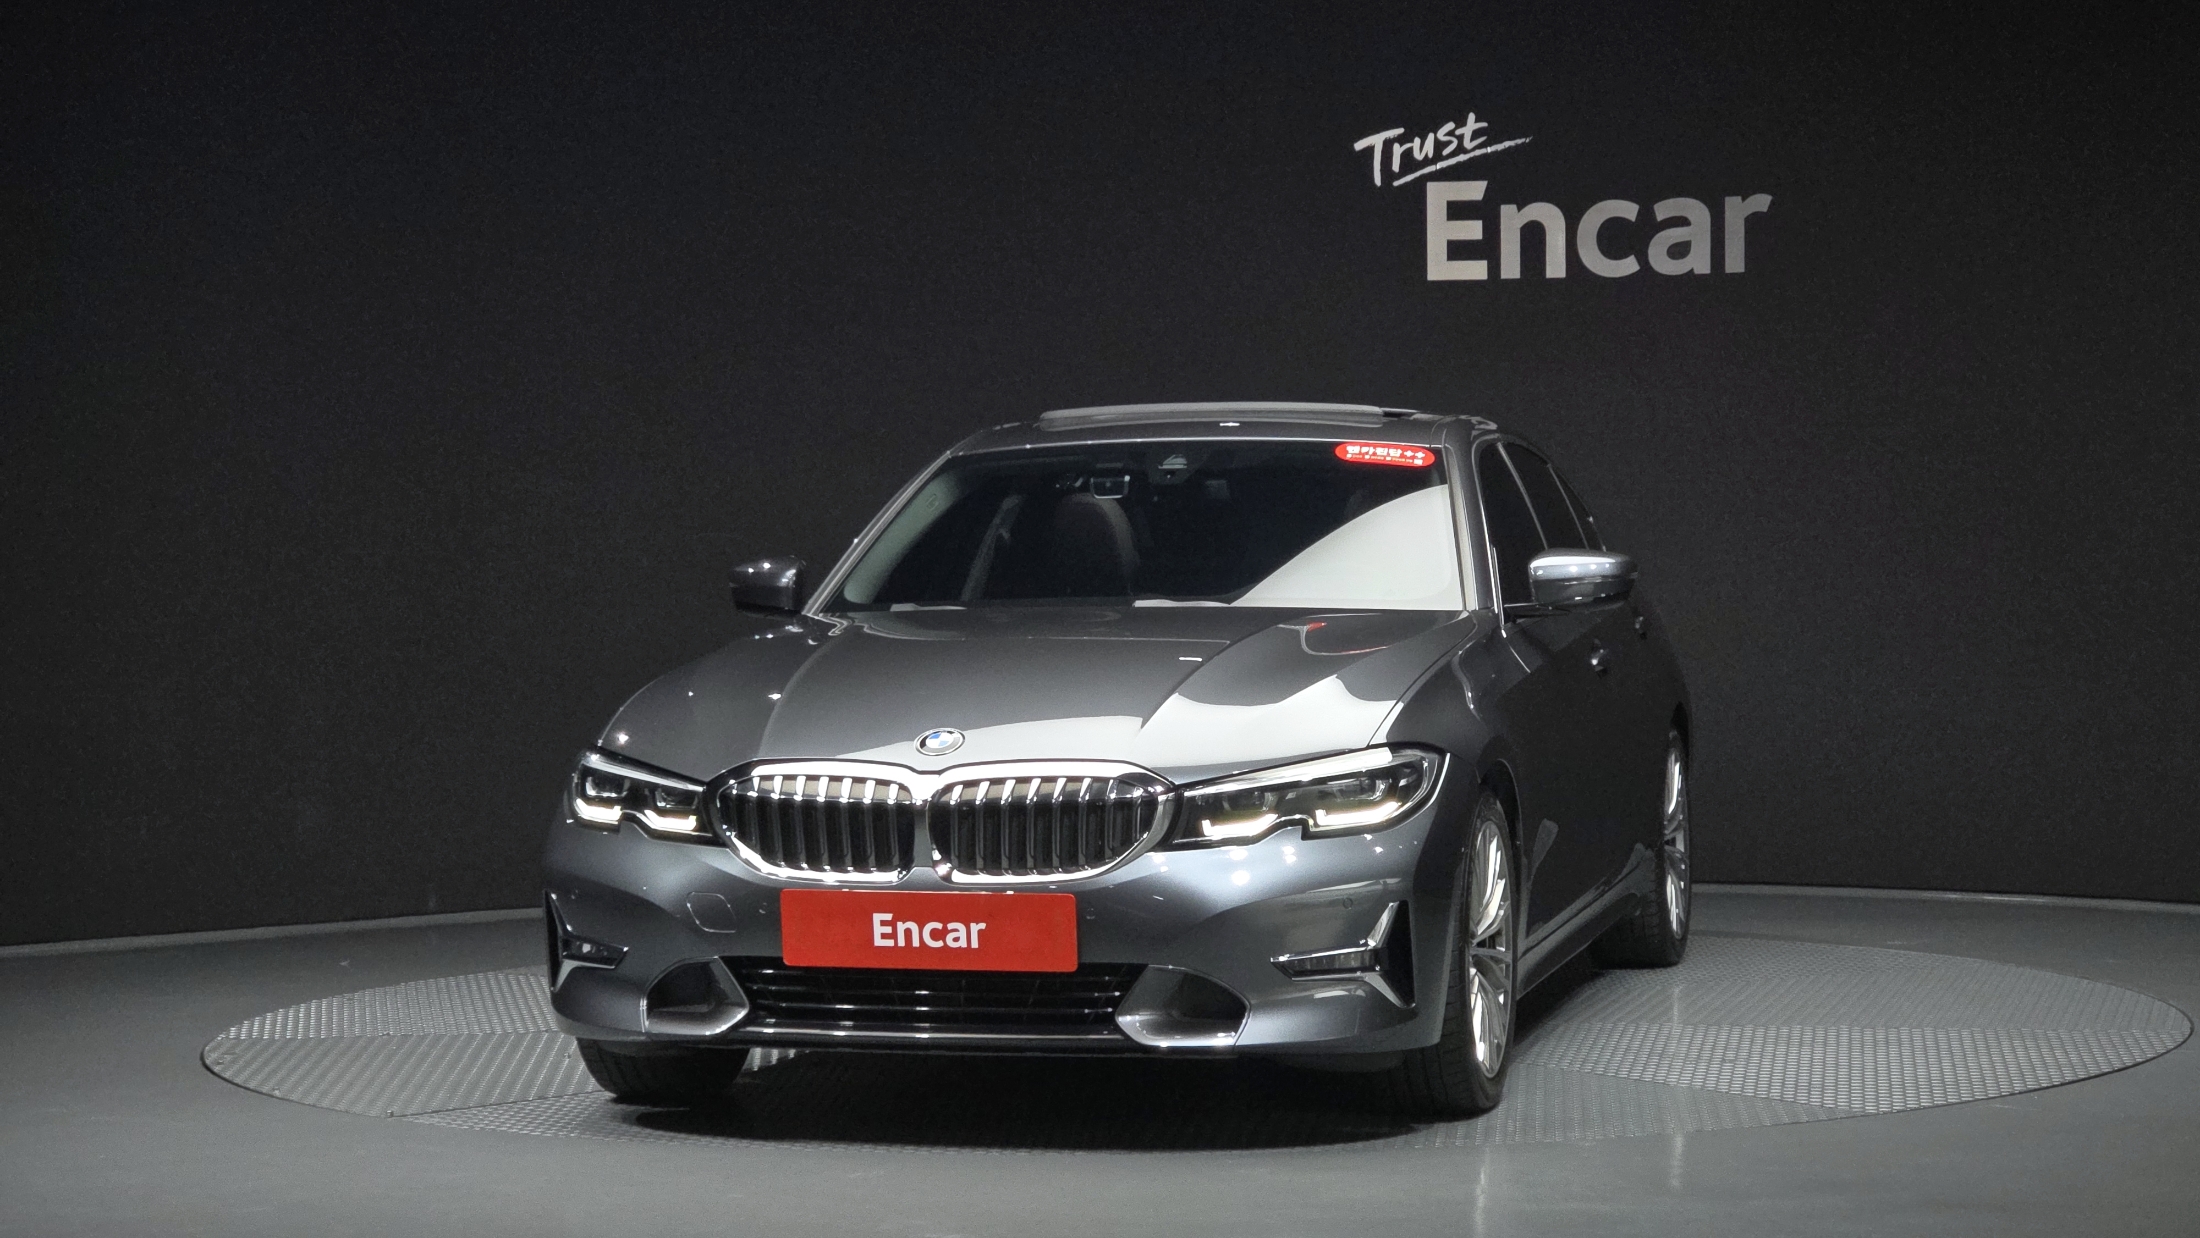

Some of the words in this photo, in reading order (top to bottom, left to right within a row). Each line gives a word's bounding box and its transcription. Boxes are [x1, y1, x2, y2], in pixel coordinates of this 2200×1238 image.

[1354, 112, 1488, 187] Trust
[1427, 181, 1773, 281] Encar
[873, 913, 986, 948] Encar
